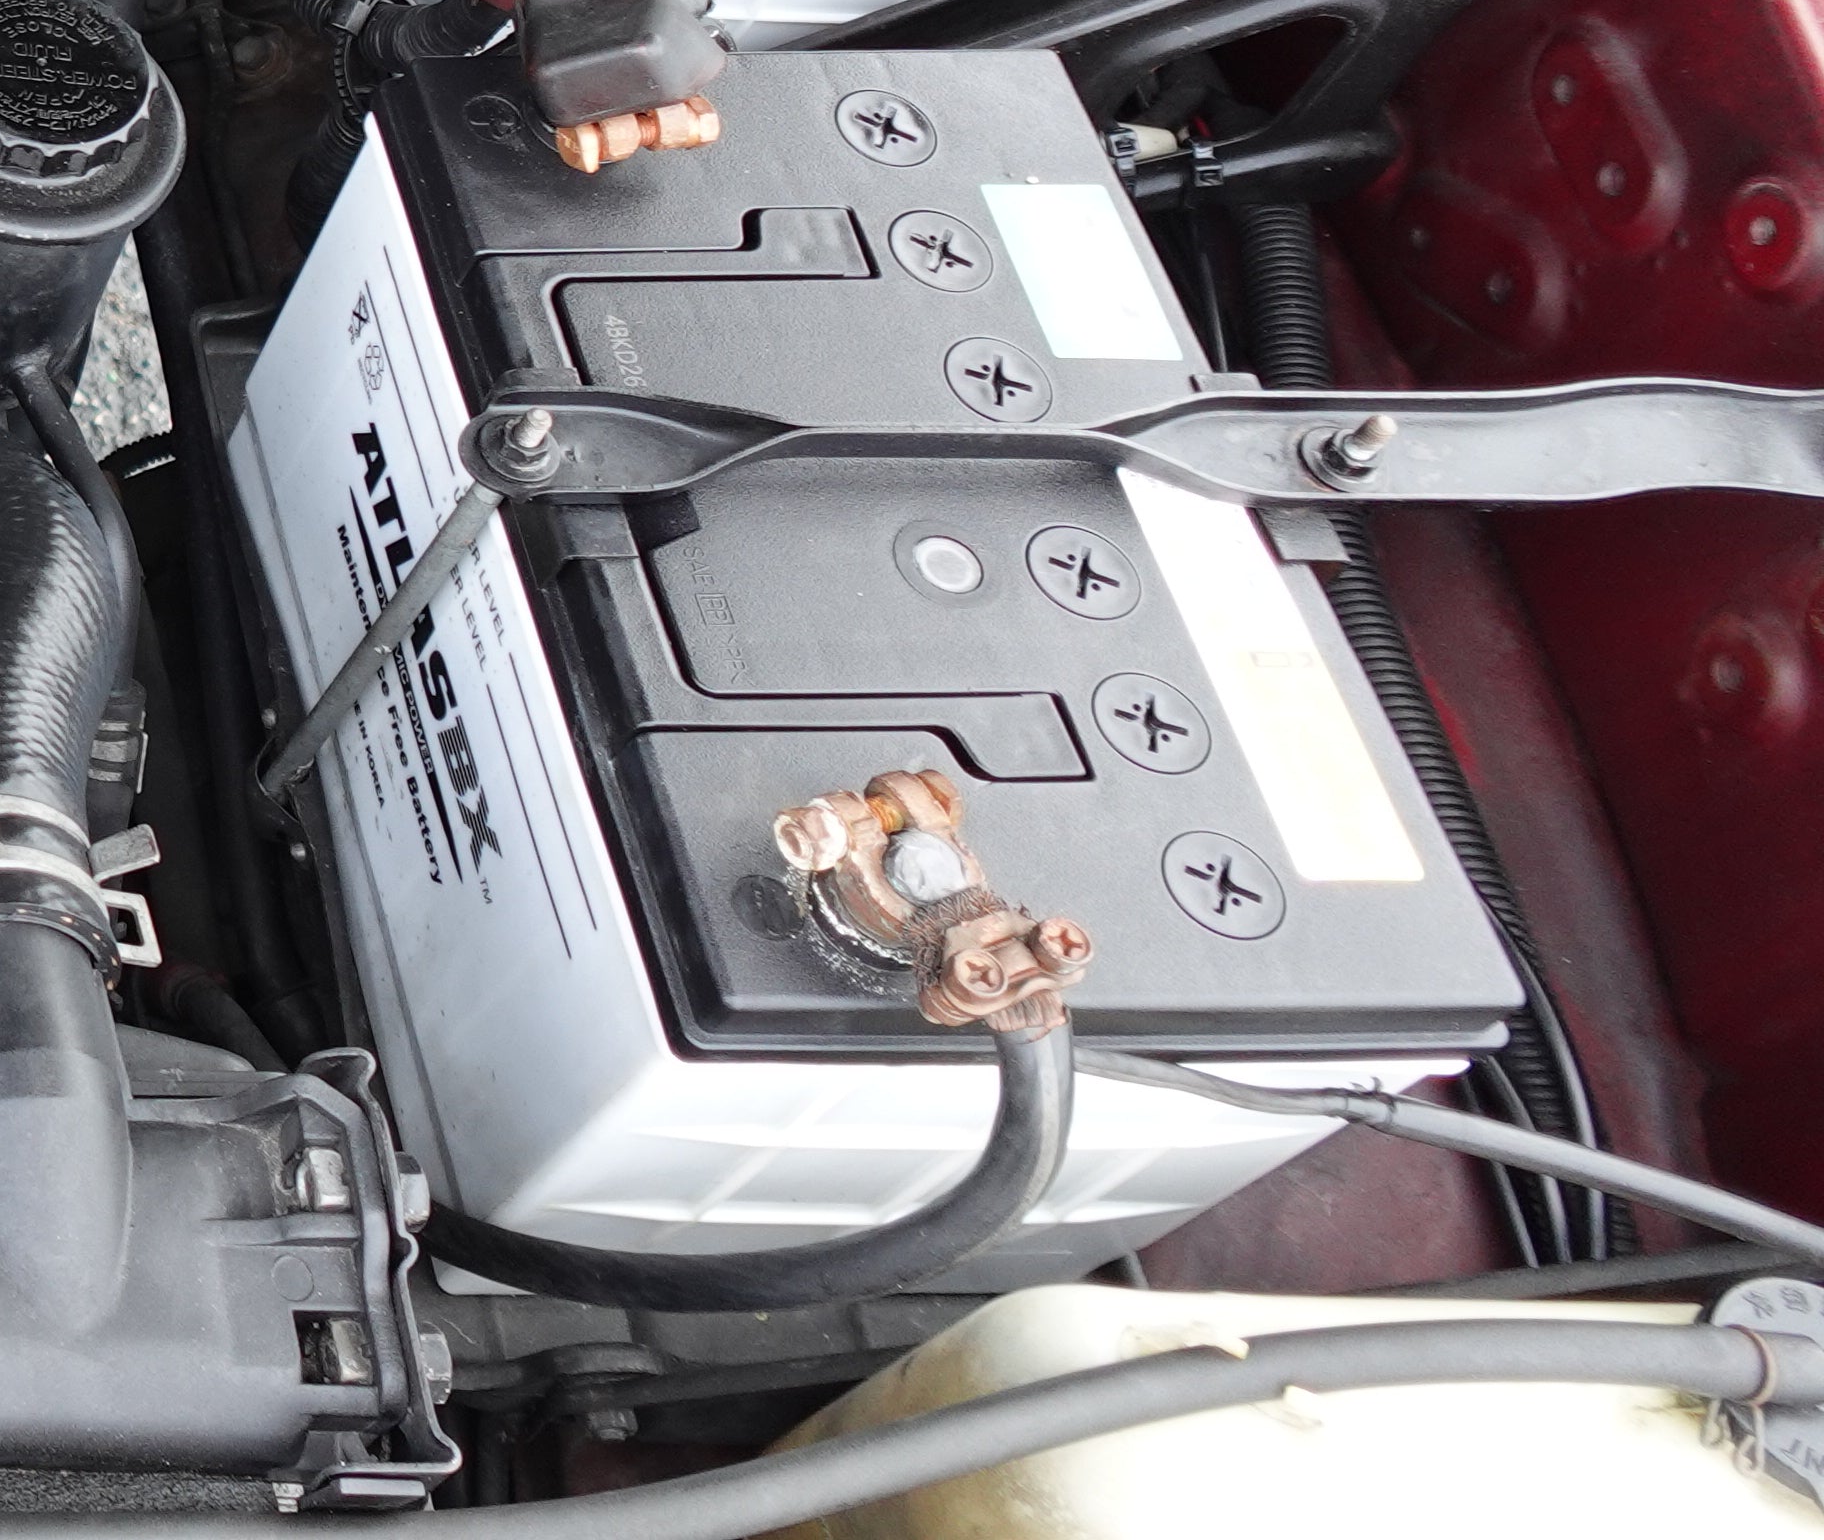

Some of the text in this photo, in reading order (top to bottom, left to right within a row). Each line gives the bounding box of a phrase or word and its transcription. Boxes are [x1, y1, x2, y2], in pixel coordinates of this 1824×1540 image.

[3, 20, 68, 39] CLOSE
[13, 42, 73, 62] FLUID
[604, 314, 649, 391] 4BKD26
[683, 545, 714, 590] SAE
[462, 597, 489, 674] LEVEL
[479, 568, 506, 648] LEVEL
[337, 524, 444, 886] Maintence Free Battery
[406, 692, 434, 775] POWER
[358, 719, 386, 810] IN KOREA
